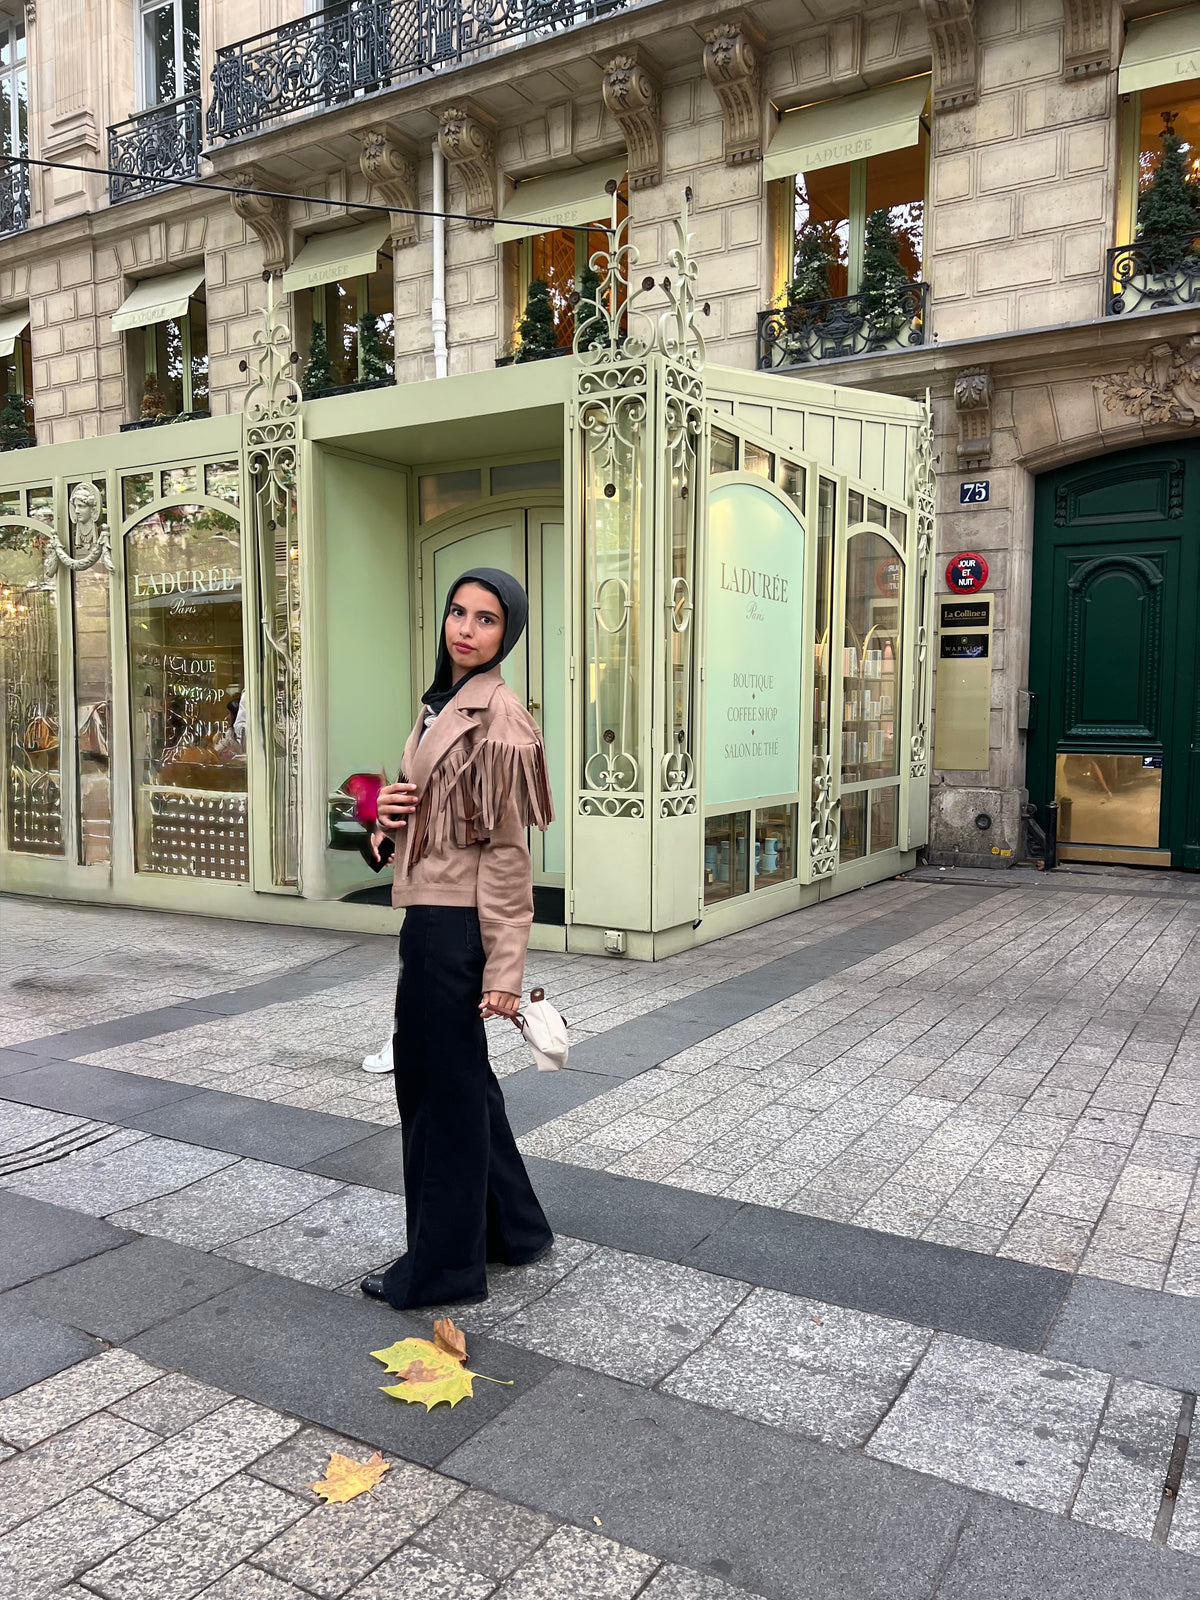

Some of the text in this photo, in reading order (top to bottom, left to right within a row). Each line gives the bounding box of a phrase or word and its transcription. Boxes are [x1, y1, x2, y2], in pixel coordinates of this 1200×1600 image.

[963, 482, 987, 502] 75
[957, 559, 976, 568] JOUR
[133, 566, 235, 597] LADURÉE
[958, 578, 974, 586] NUIT
[961, 569, 972, 577] ET
[720, 562, 789, 603] LADURÉE
[169, 598, 197, 615] Paris
[745, 600, 765, 622] Paris
[954, 609, 981, 618] Colline
[733, 673, 774, 692] BOUTIQUE
[727, 706, 778, 722] COFFEE SHOP
[724, 738, 779, 759] SALON DE THÉ
